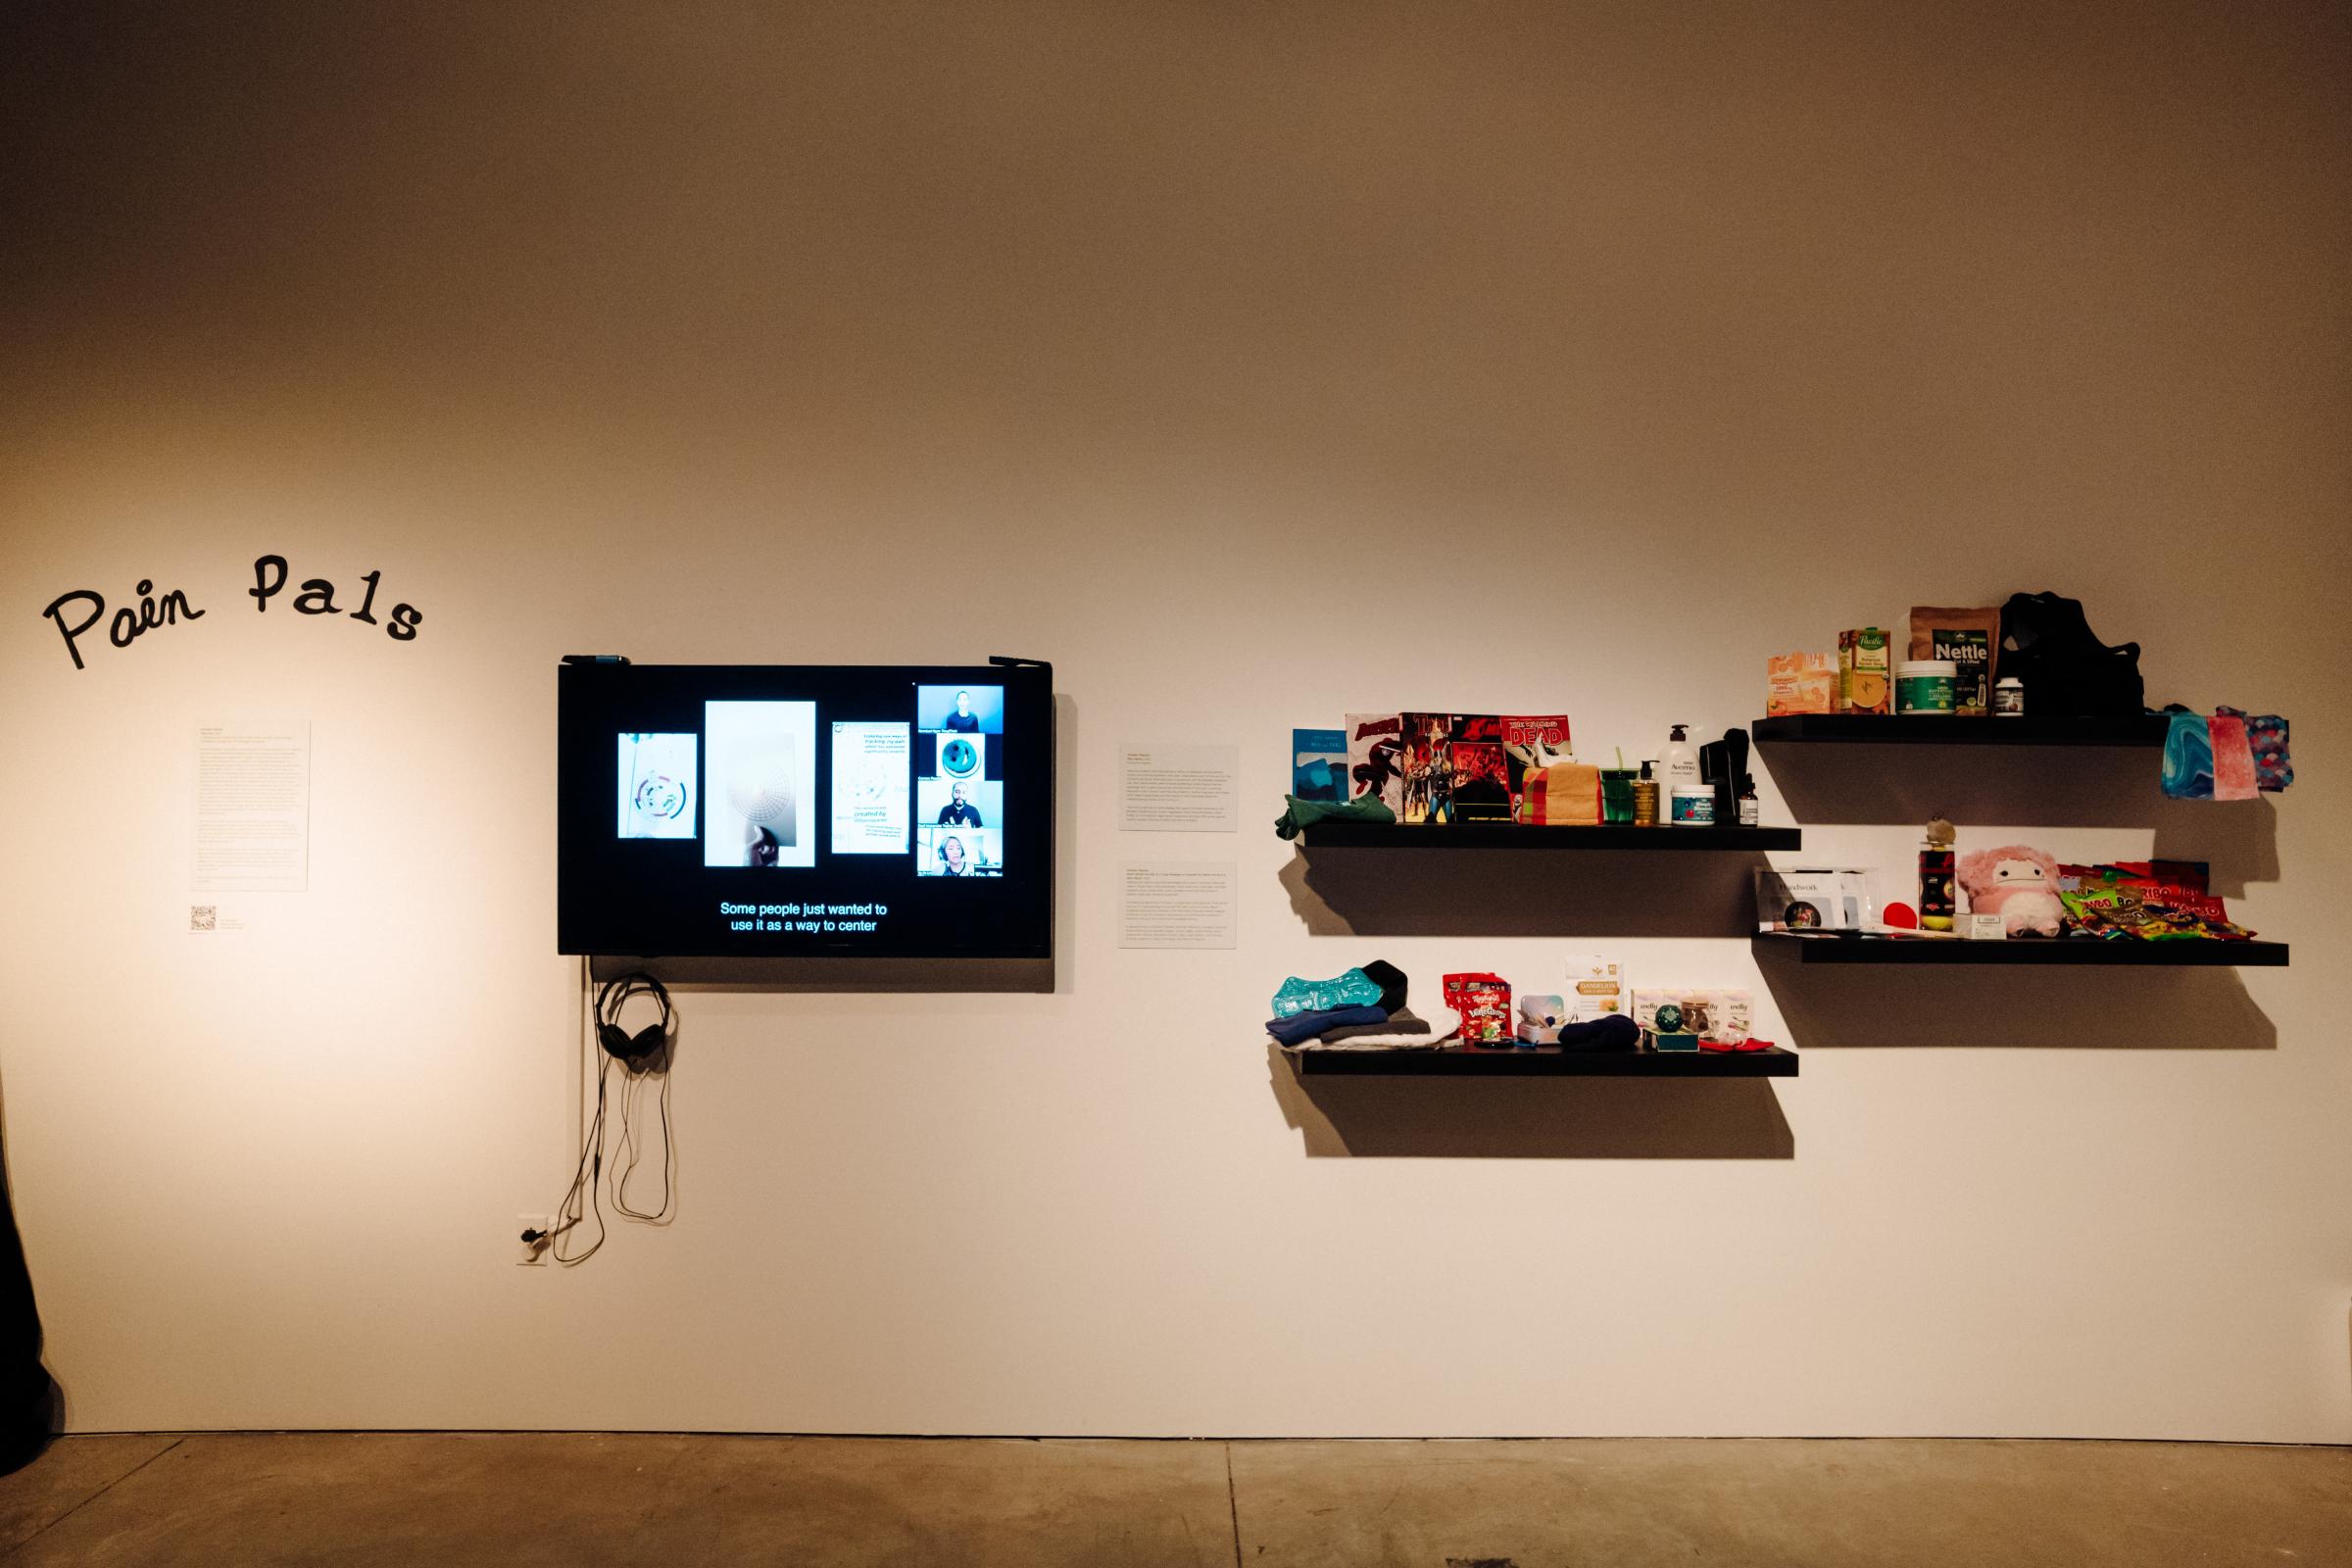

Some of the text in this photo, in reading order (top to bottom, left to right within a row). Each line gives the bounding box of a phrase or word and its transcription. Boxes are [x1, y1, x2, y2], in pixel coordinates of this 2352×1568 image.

[42, 554, 423, 669] Pain Pals
[1935, 643, 1987, 660] Nettle
[1509, 727, 1563, 747] DEAD
[720, 903, 888, 917] Some people just wanted to
[730, 918, 877, 933] use it as a way to center
